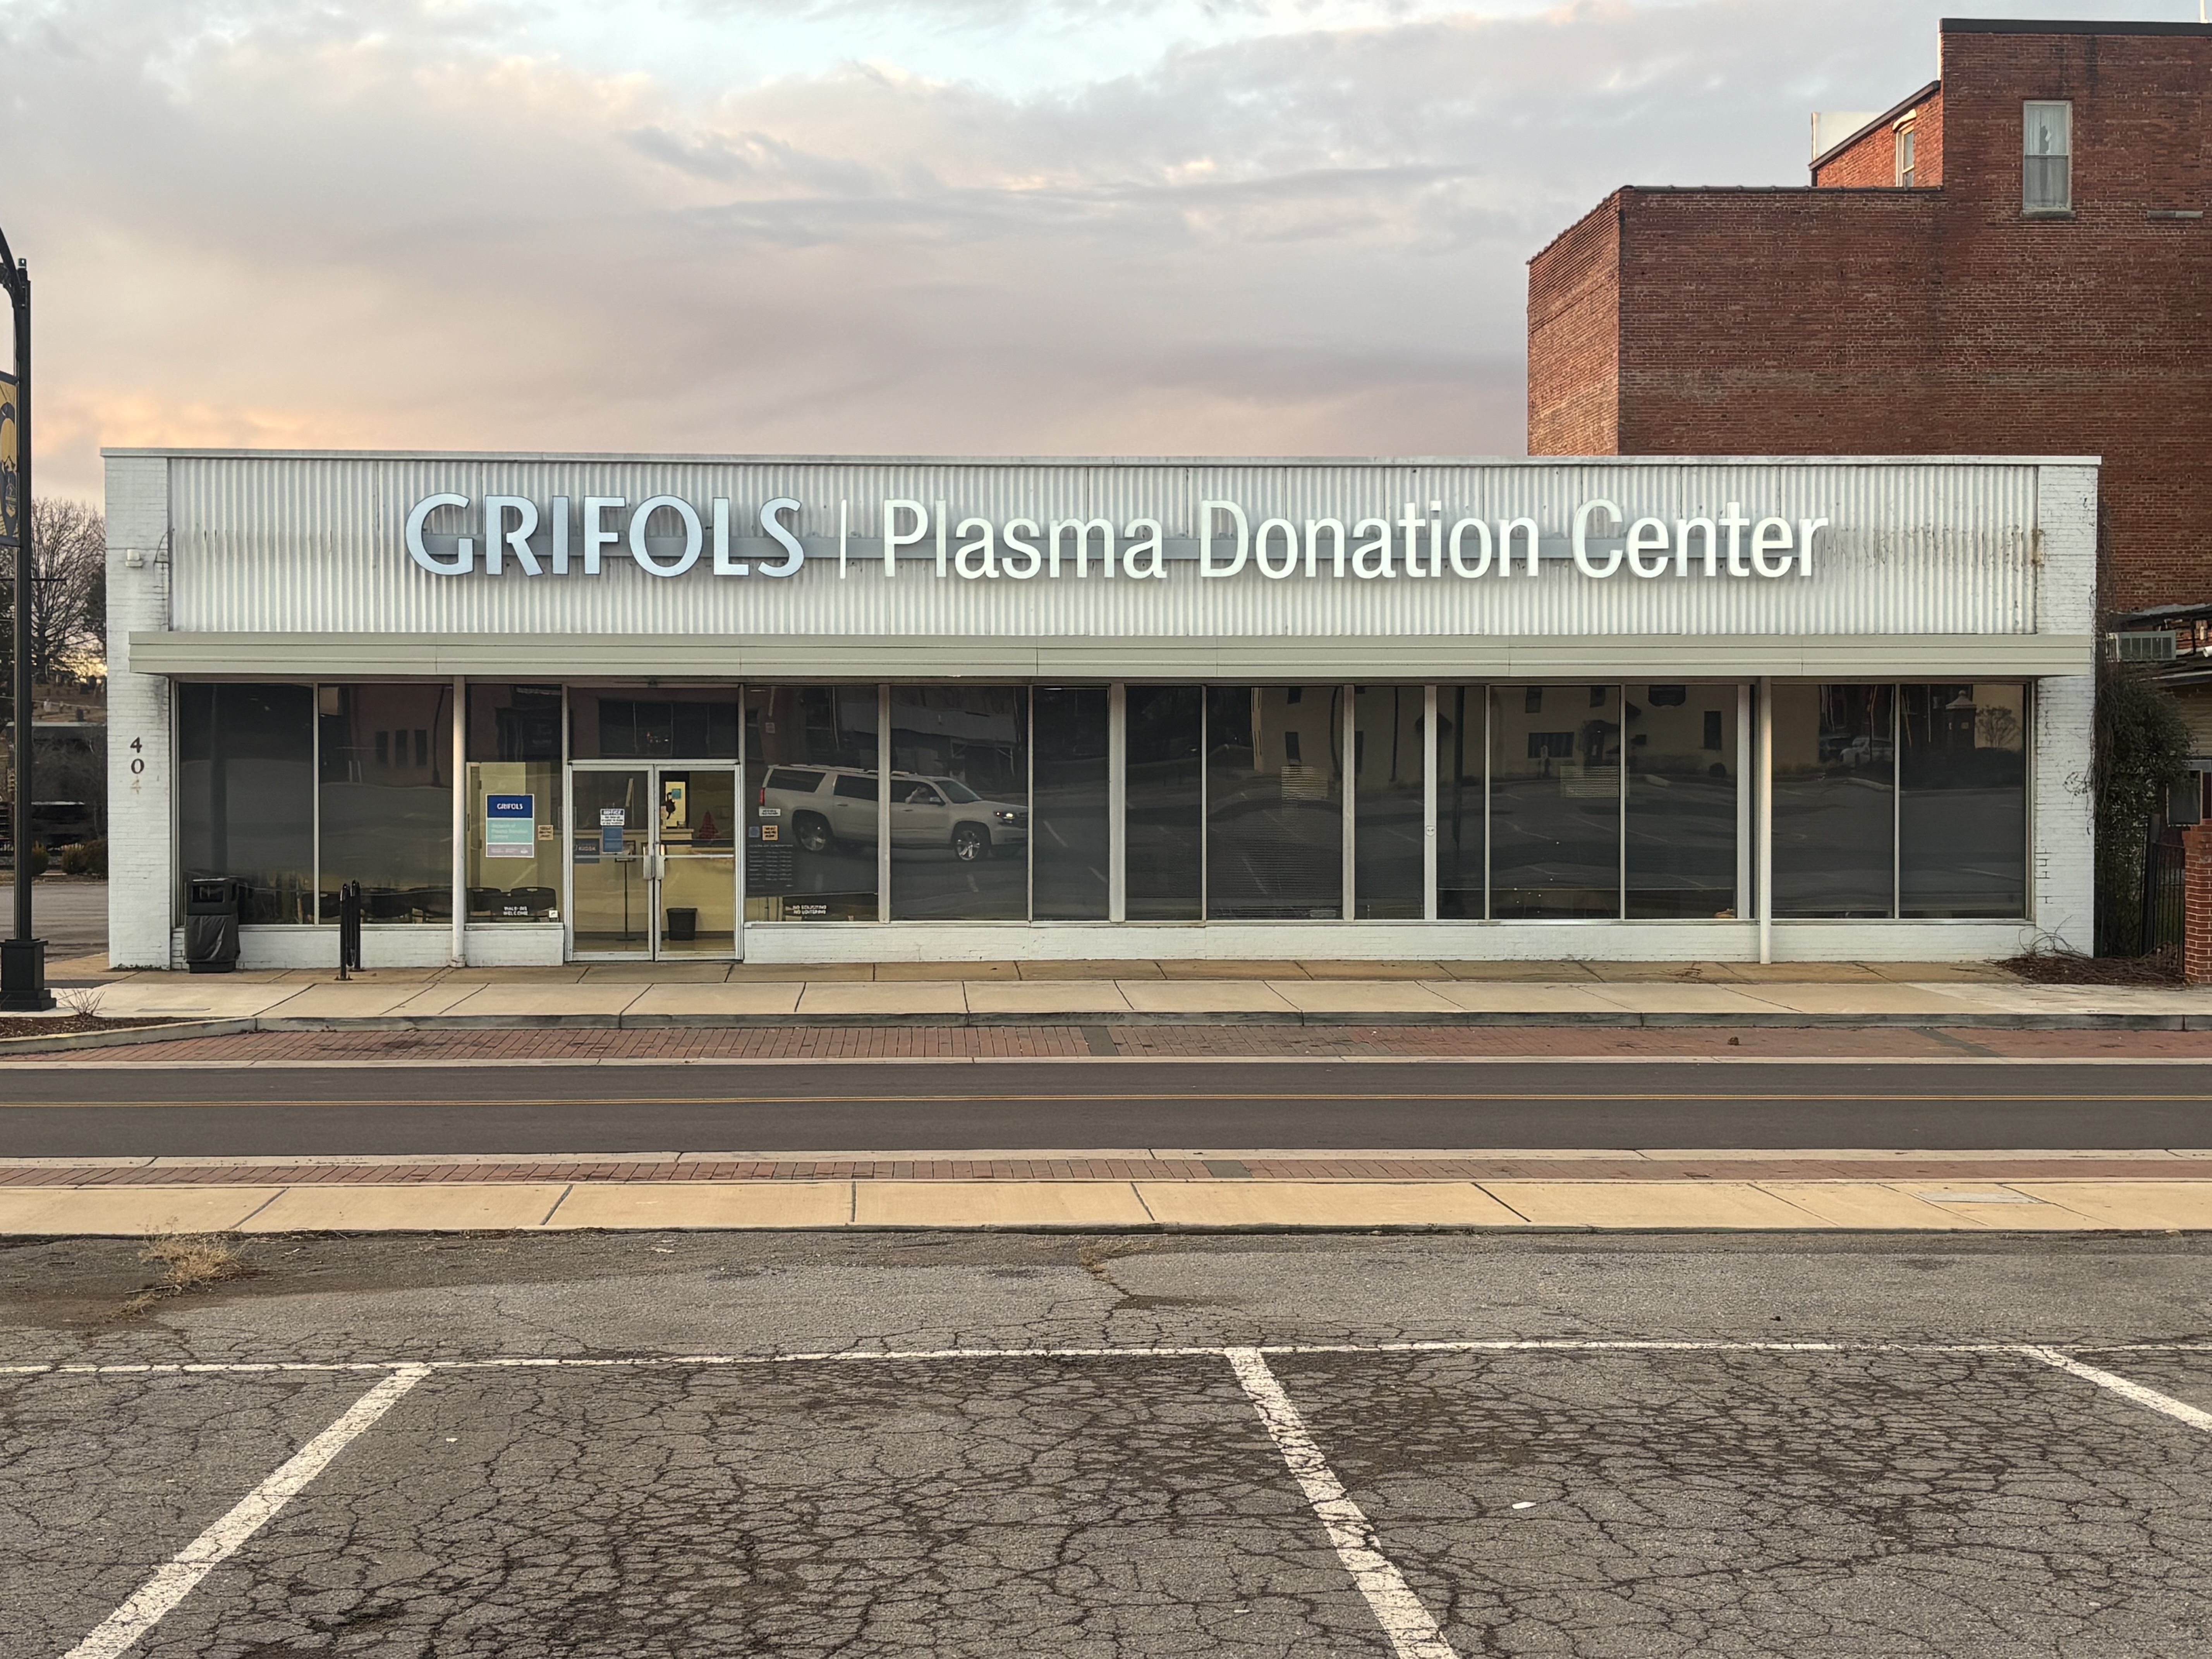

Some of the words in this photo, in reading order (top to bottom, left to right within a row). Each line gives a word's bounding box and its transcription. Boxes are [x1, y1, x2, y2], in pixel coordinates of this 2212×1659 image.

[405, 492, 805, 578] GRIFOLS
[883, 499, 1167, 580] Plasma
[1200, 499, 1540, 579] Donation
[1572, 498, 1828, 579] Center
